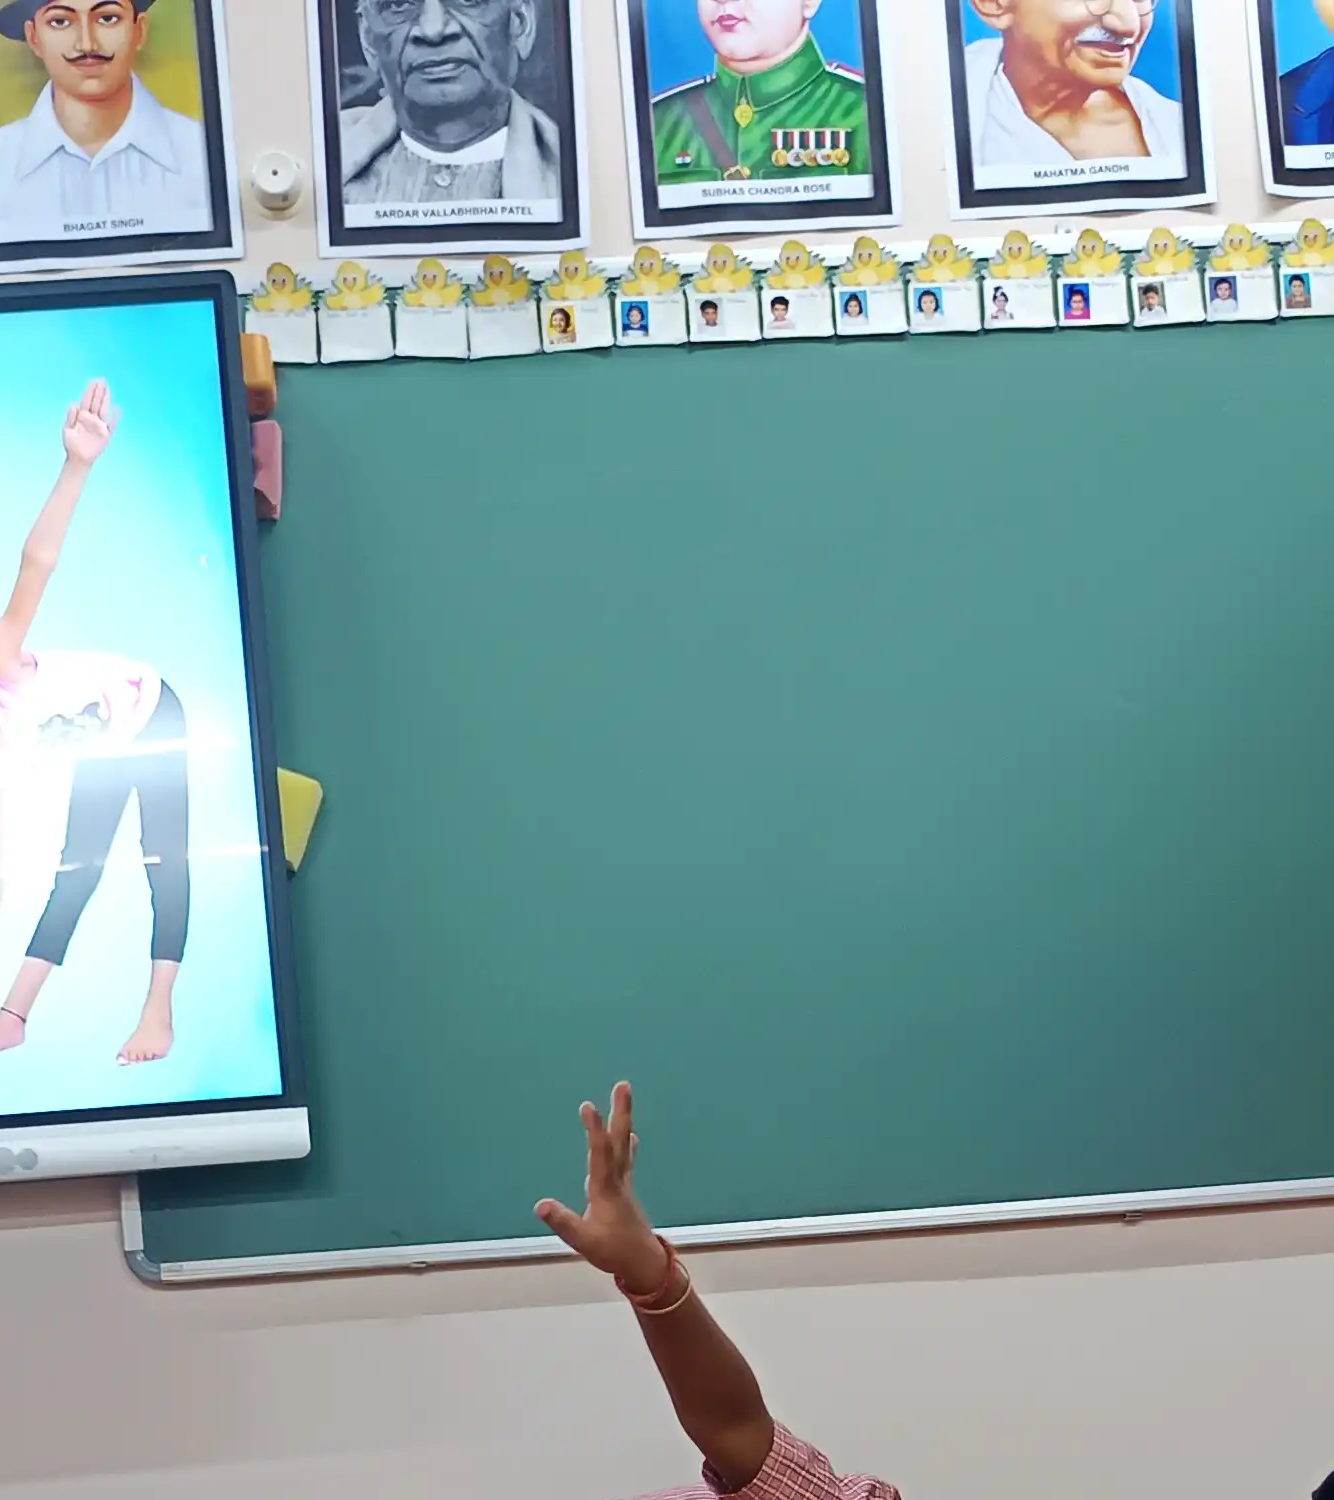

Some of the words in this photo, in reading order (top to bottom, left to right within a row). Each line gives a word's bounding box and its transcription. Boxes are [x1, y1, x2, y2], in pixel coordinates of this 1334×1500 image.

[1033, 168, 1086, 179] MAHATMA
[1089, 164, 1130, 174] GANDHI
[701, 187, 745, 198] SUBHAS
[748, 185, 800, 196] CHANDRA
[803, 183, 832, 193] BOSE
[374, 209, 419, 219] SARDAR
[422, 206, 498, 218] VALLABHBHAI
[501, 206, 534, 215] PATEL
[63, 221, 107, 232] BHAGAT
[111, 218, 144, 229] SINGH
